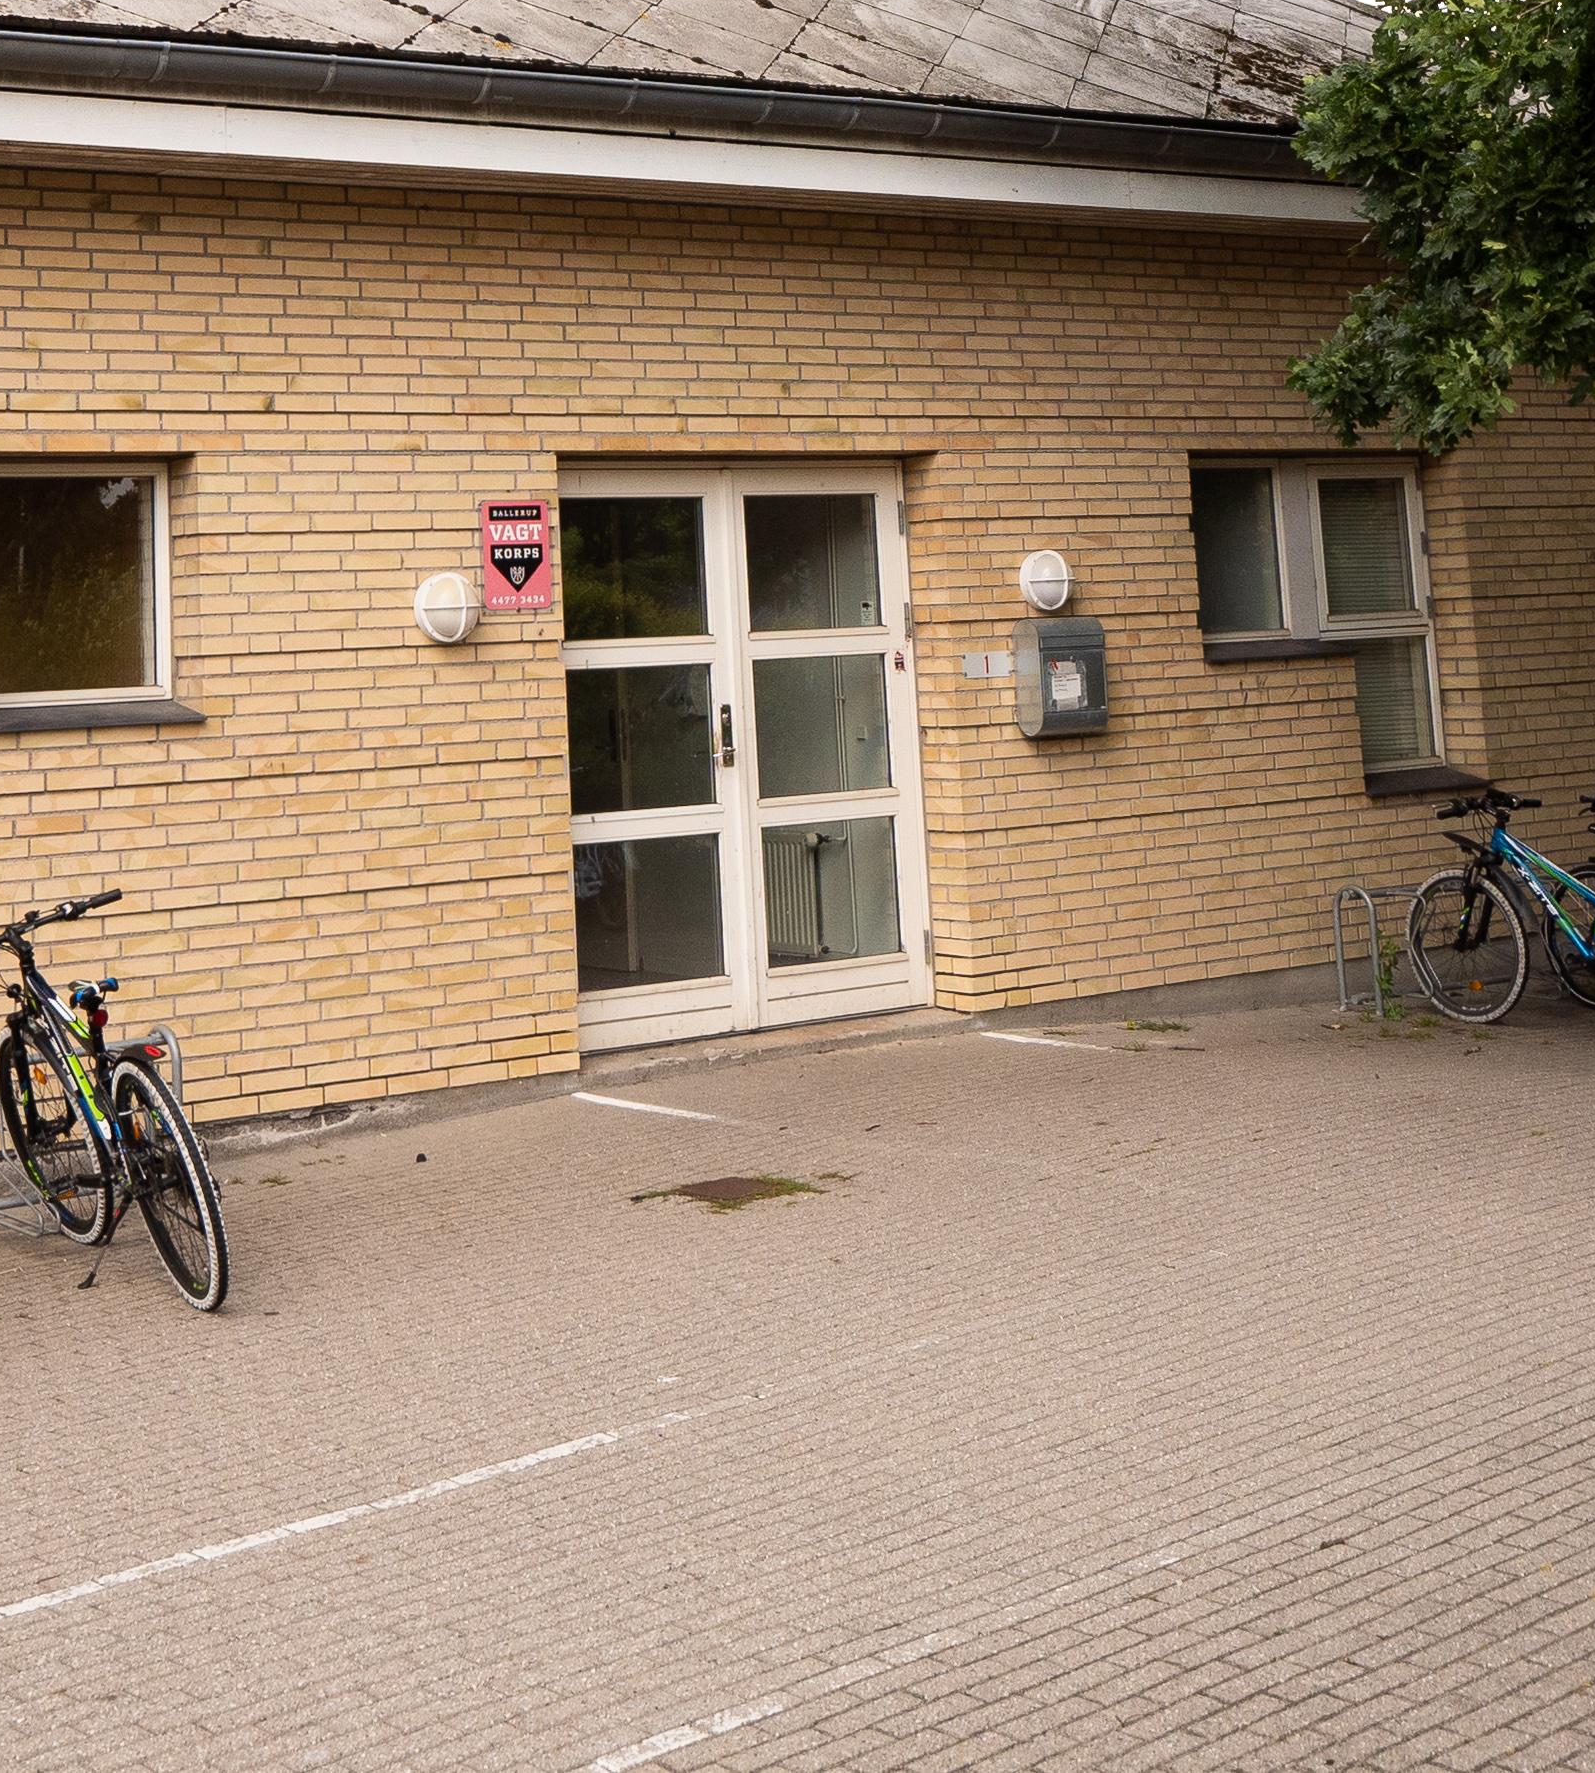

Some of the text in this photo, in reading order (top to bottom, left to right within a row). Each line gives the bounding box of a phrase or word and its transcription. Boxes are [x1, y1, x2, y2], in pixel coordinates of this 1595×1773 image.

[492, 509, 537, 517] BALLERUP
[488, 524, 542, 541] VAGT
[494, 548, 540, 559] KORPS
[491, 596, 516, 604] 4477
